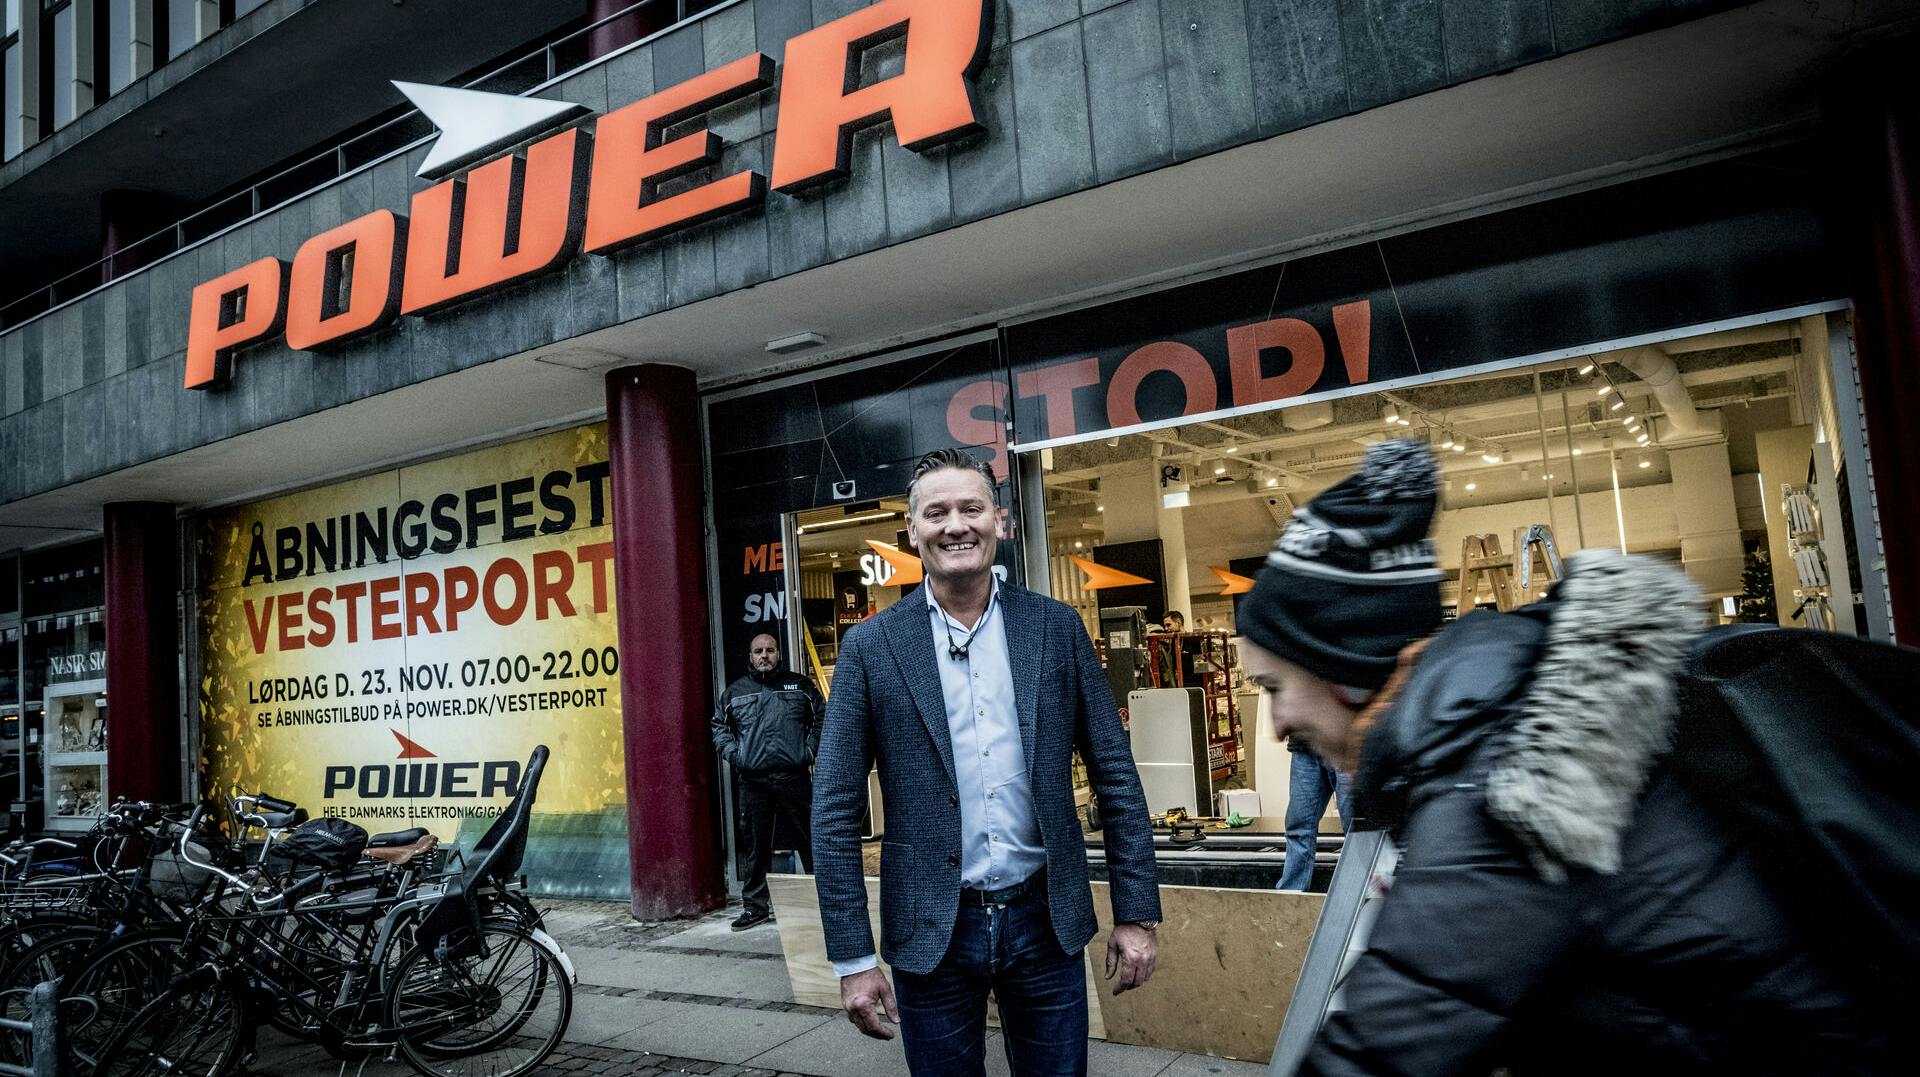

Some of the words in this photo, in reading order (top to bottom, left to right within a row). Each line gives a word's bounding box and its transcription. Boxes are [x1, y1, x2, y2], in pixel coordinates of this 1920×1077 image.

[184, 0, 994, 391] POWER
[946, 300, 1371, 483] STOP!
[241, 461, 611, 587] ÅBNINGSFEST
[860, 553, 896, 586] SU
[243, 541, 615, 655] VESTERPORT
[743, 590, 787, 623] SN
[50, 654, 87, 676] NASIR
[249, 674, 328, 705] LØRDAG
[335, 673, 354, 698] D.
[361, 669, 391, 695] 23.
[400, 663, 453, 693] NOV.
[461, 646, 619, 688] 07.00-22.00
[258, 712, 272, 727] SE
[275, 704, 379, 727] ÅBNINGSTILBUD
[384, 699, 402, 720] PÅ
[407, 688, 608, 718] POWER.DK/VESTERPORT
[324, 760, 521, 799] POWER
[323, 806, 347, 818] HELE
[350, 806, 405, 819] DANMARKS
[408, 805, 508, 819] ELEKTRONIKGIGA
